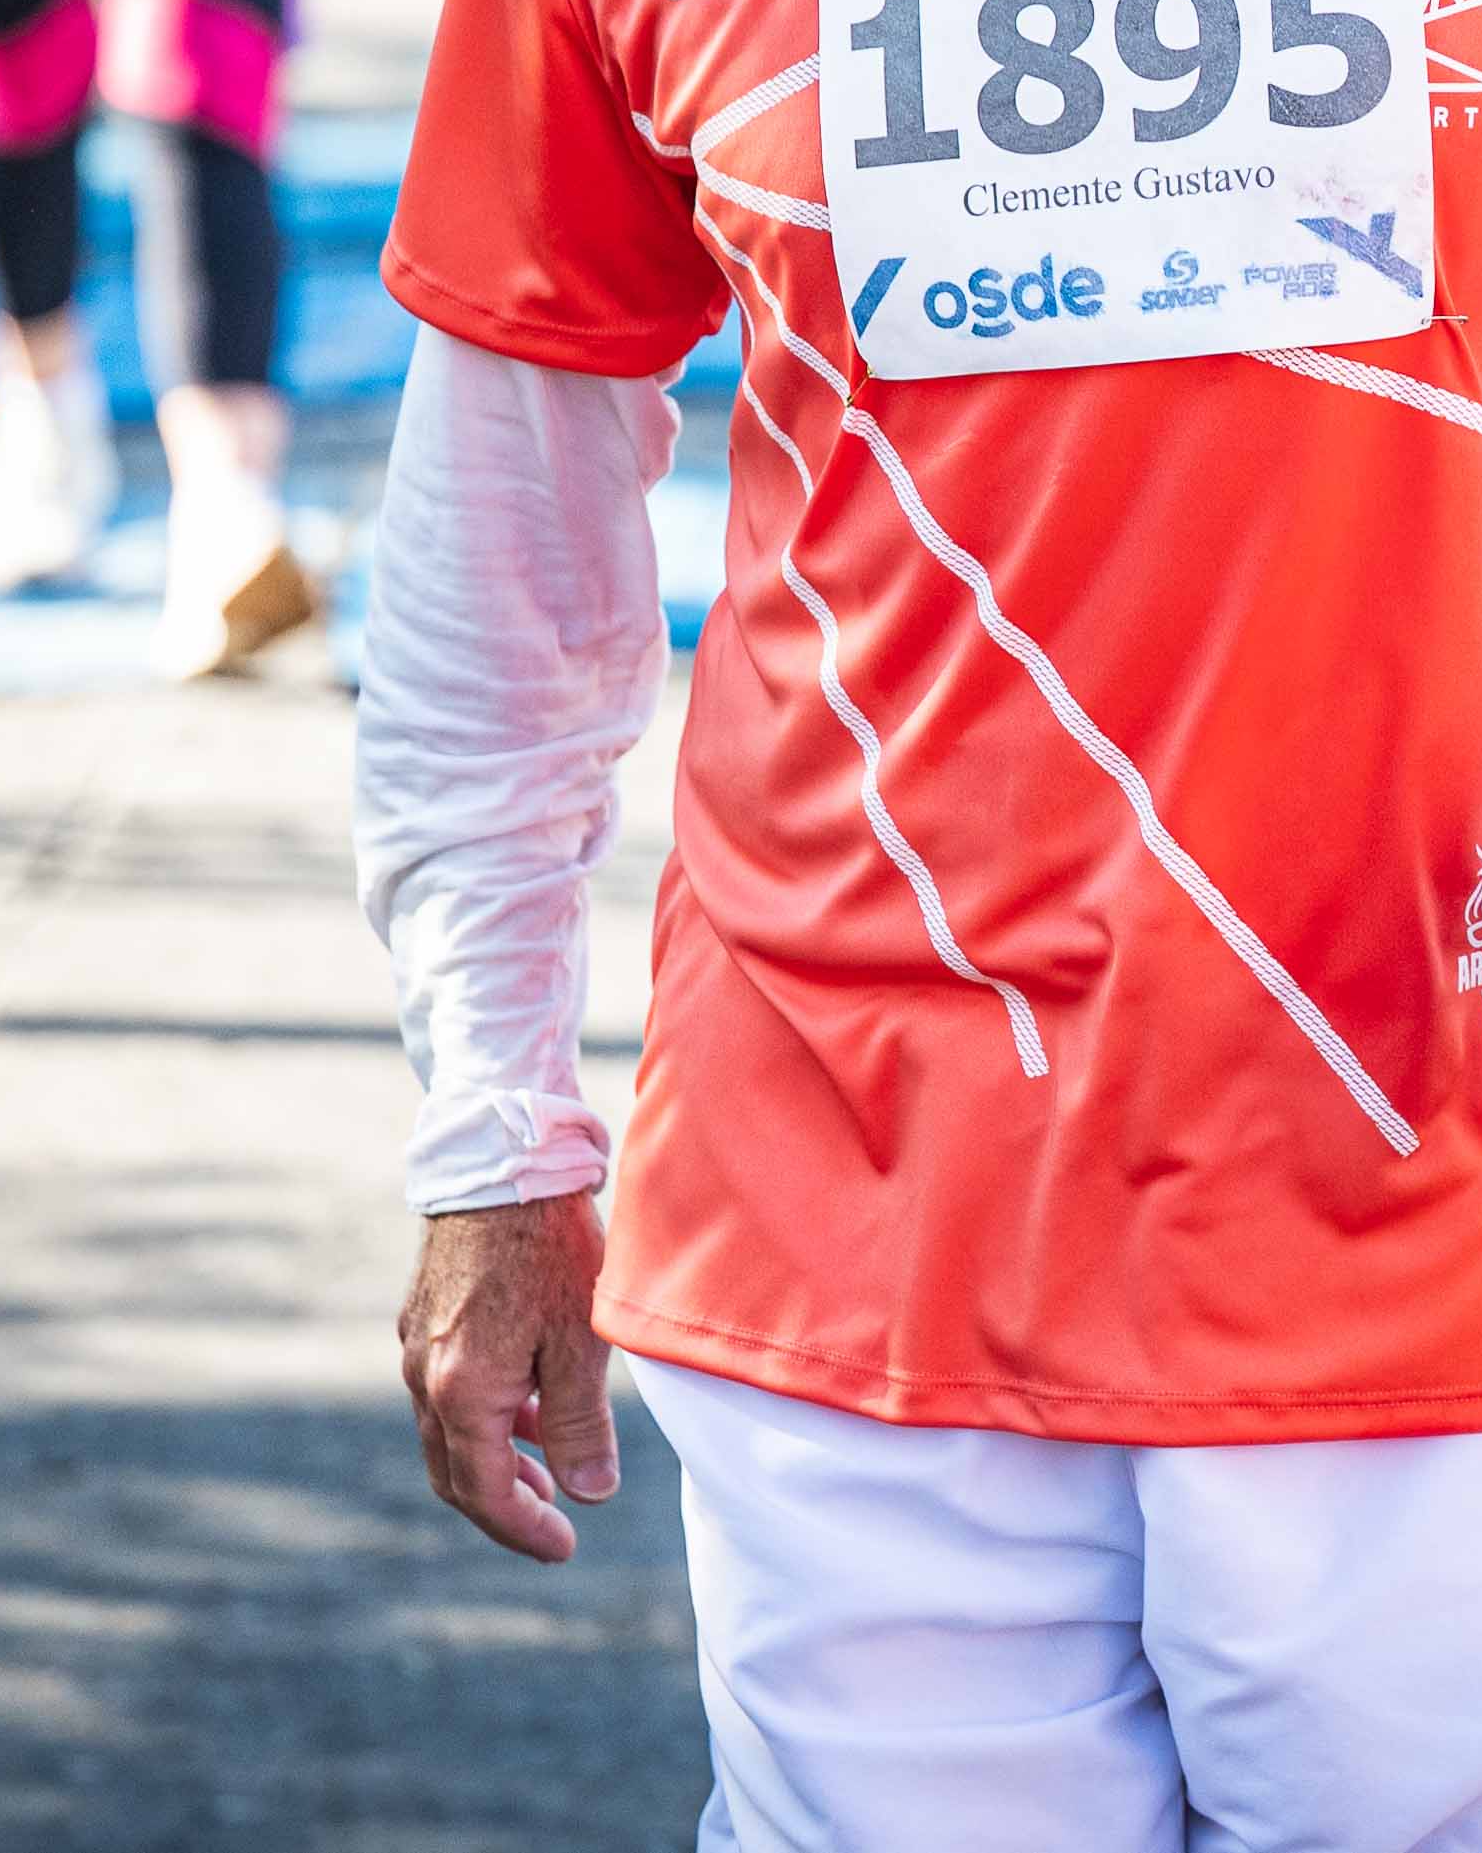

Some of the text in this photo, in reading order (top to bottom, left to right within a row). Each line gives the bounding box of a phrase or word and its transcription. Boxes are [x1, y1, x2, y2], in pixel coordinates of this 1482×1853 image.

[963, 164, 1275, 218] Clemente Gustavo
[923, 251, 1106, 332] osde
[1244, 263, 1337, 286] POWER
